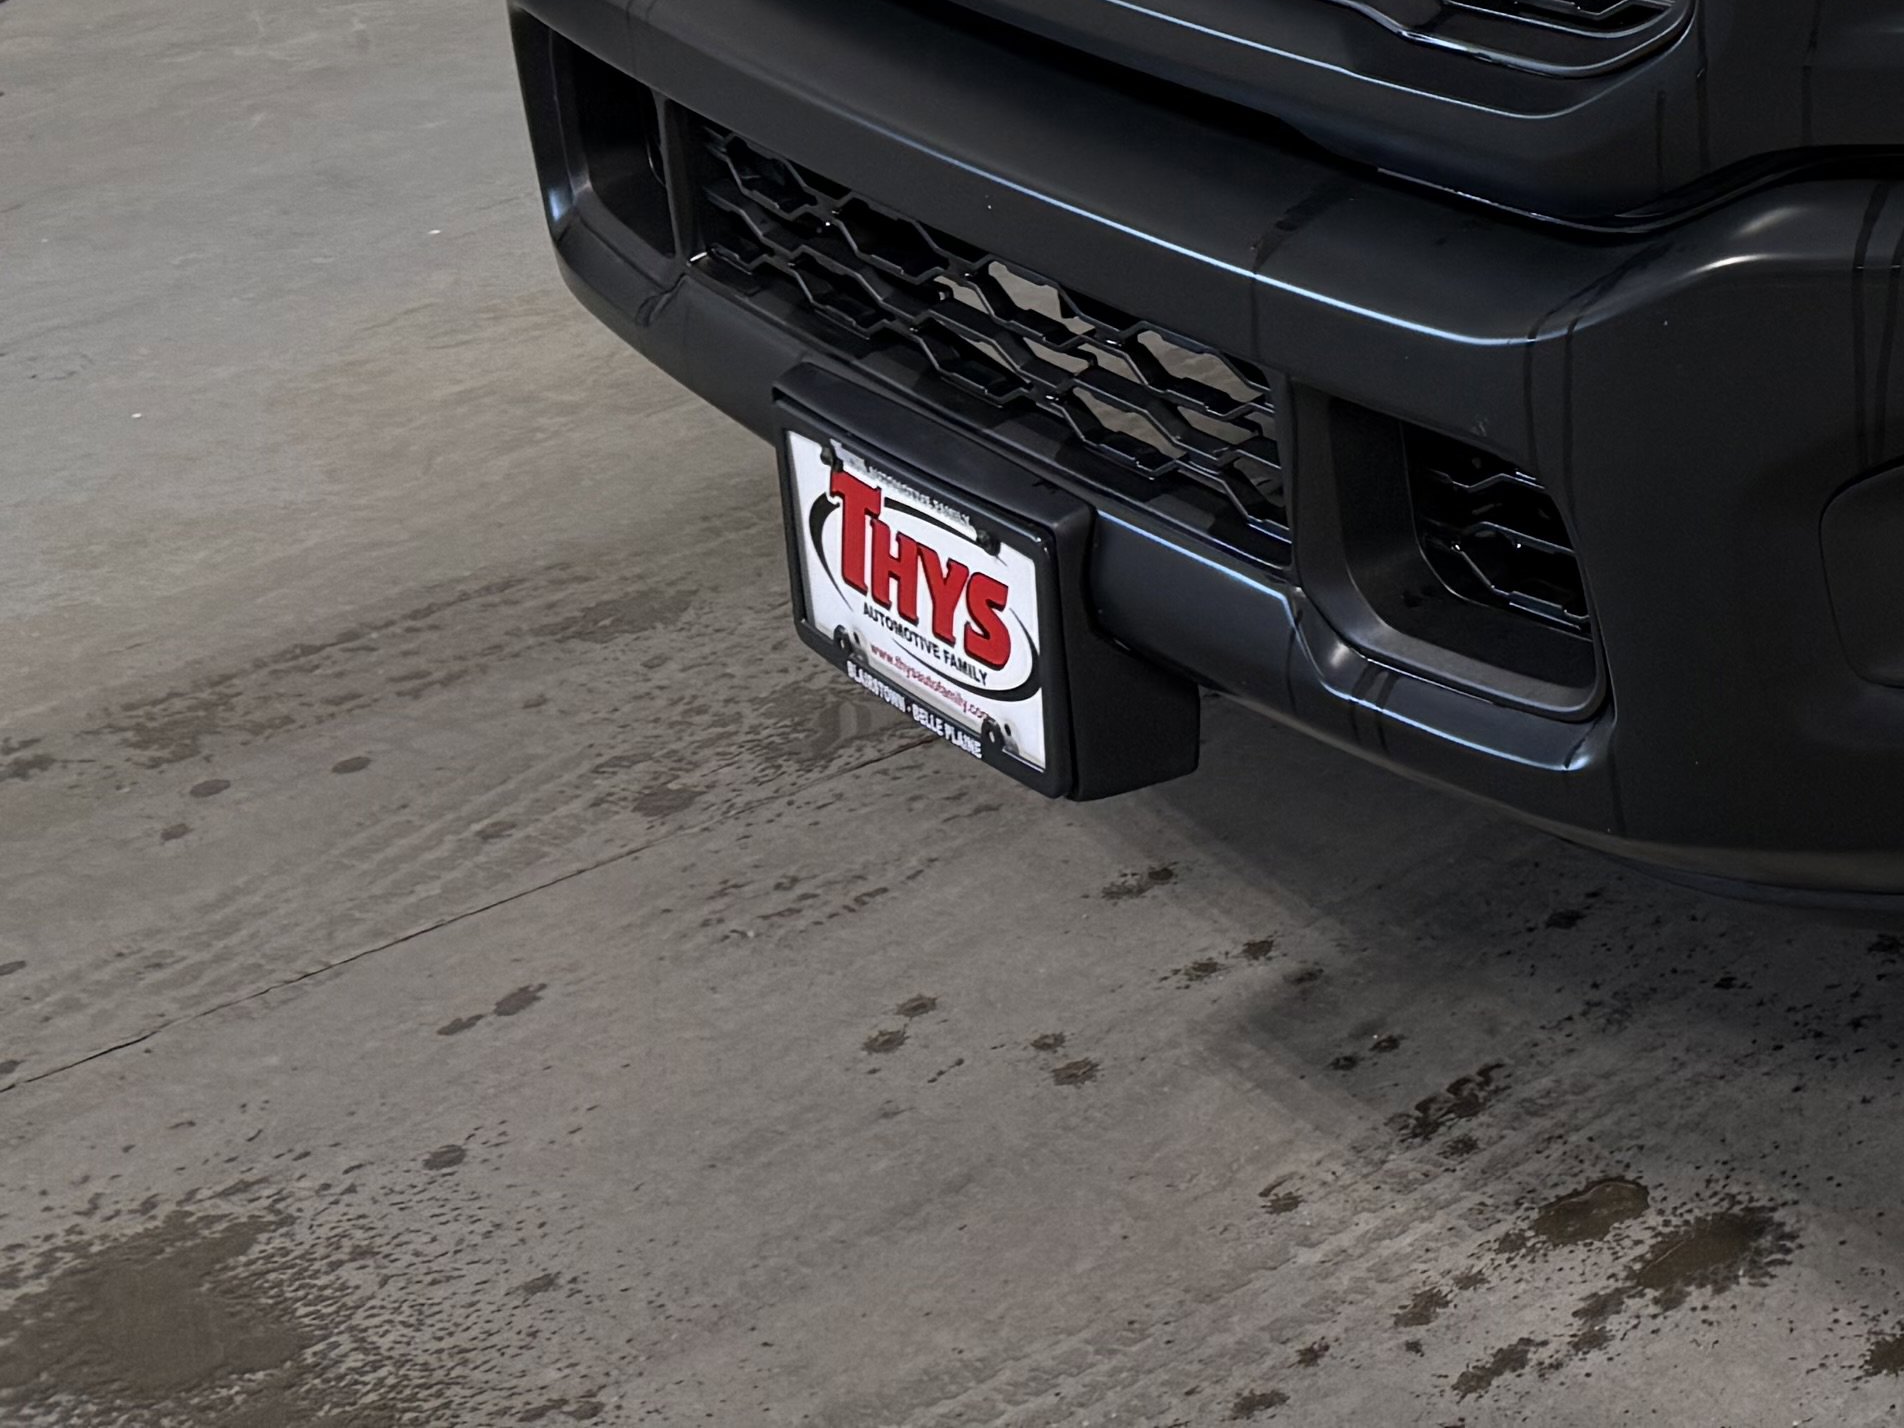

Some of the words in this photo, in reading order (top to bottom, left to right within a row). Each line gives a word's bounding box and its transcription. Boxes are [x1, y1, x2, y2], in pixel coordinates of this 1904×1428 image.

[829, 467, 1012, 670] THYS
[863, 601, 942, 660] AUTOMOTIVE
[943, 649, 988, 686] FAMILY
[912, 703, 945, 737] BELLE
